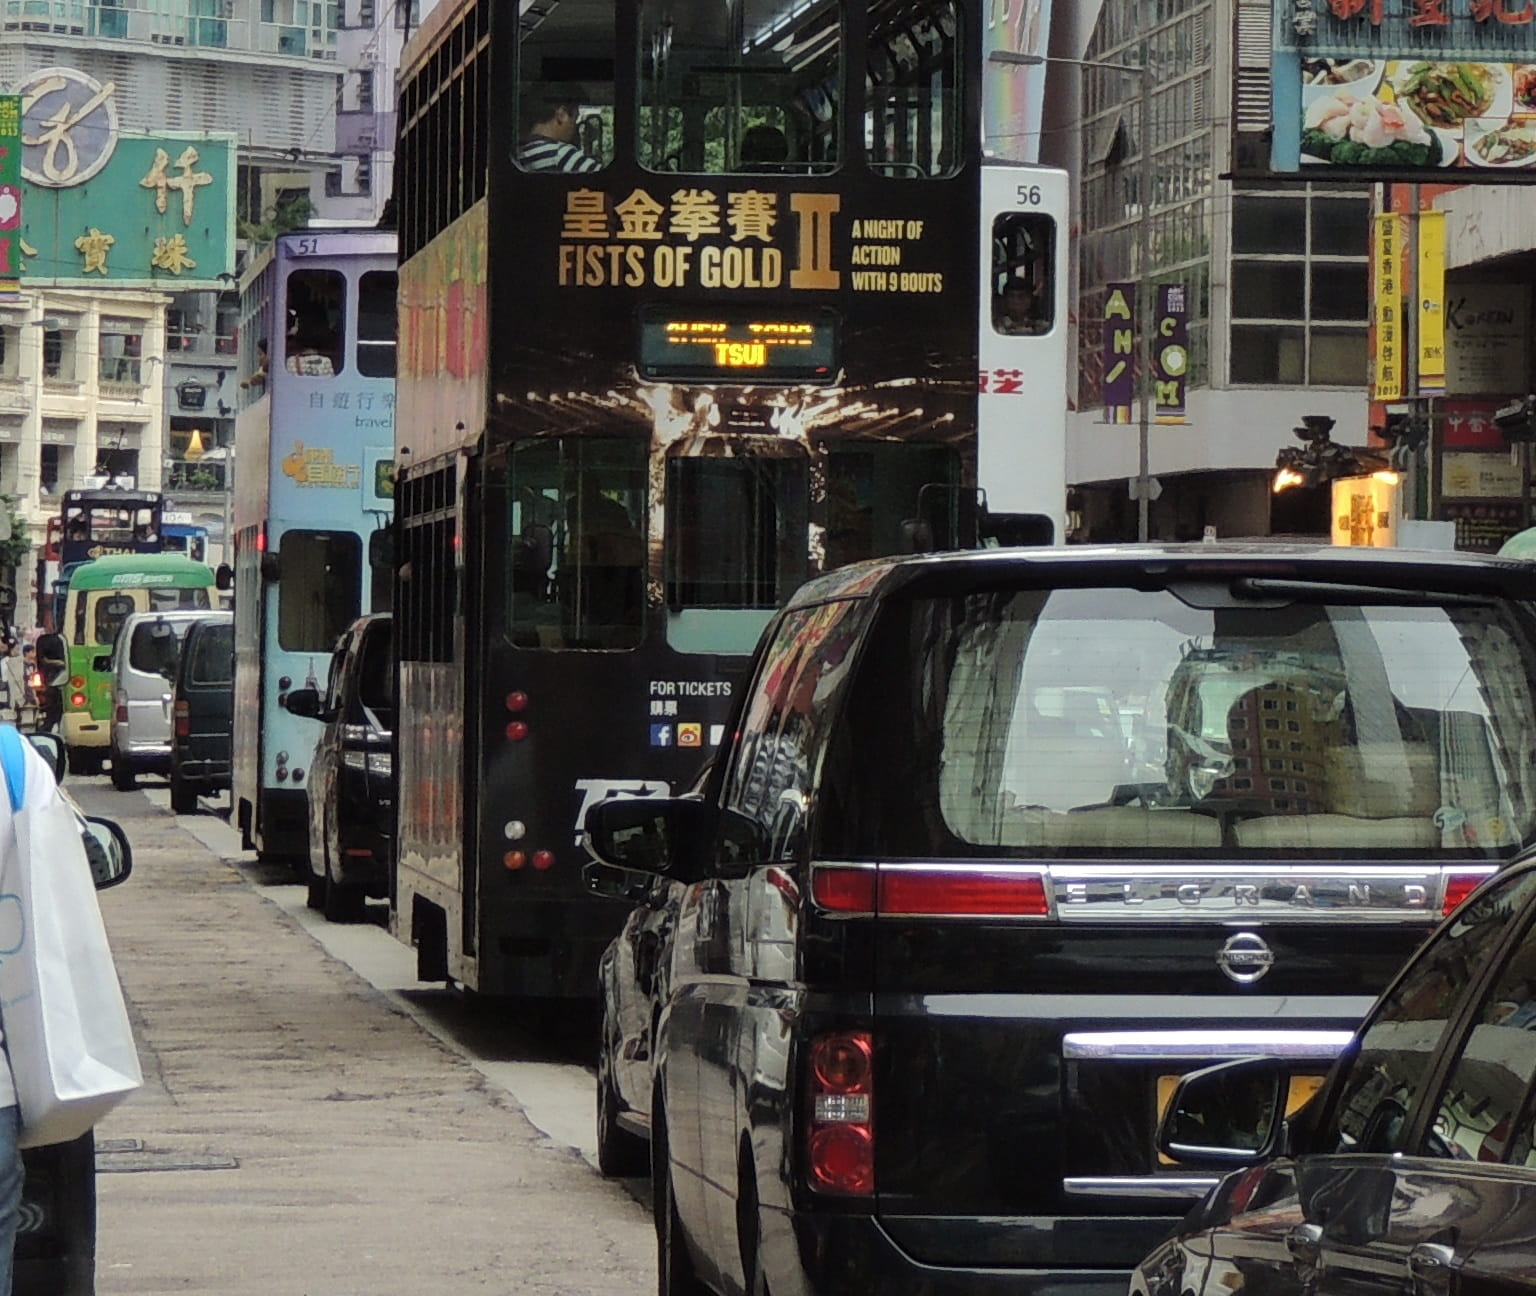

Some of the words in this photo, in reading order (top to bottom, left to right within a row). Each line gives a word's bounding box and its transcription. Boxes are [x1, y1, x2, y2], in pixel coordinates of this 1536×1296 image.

[1016, 185, 1041, 205] 56
[560, 188, 777, 242] 皇金拳賽
[851, 220, 862, 239] A
[864, 219, 904, 239] NIGHT
[906, 220, 924, 239] OF
[298, 239, 318, 255] 51
[851, 246, 900, 266] ACTION
[559, 246, 645, 287] FISTS
[653, 246, 693, 288] OF
[700, 246, 782, 289] GOLD
[851, 270, 886, 291] WITH
[888, 272, 898, 292] 9
[900, 272, 943, 293] BOUTS
[715, 343, 765, 366] TSUI
[650, 680, 676, 696] FOR
[677, 681, 732, 697] TICKETS
[1066, 883, 1428, 906] ELGRAND
